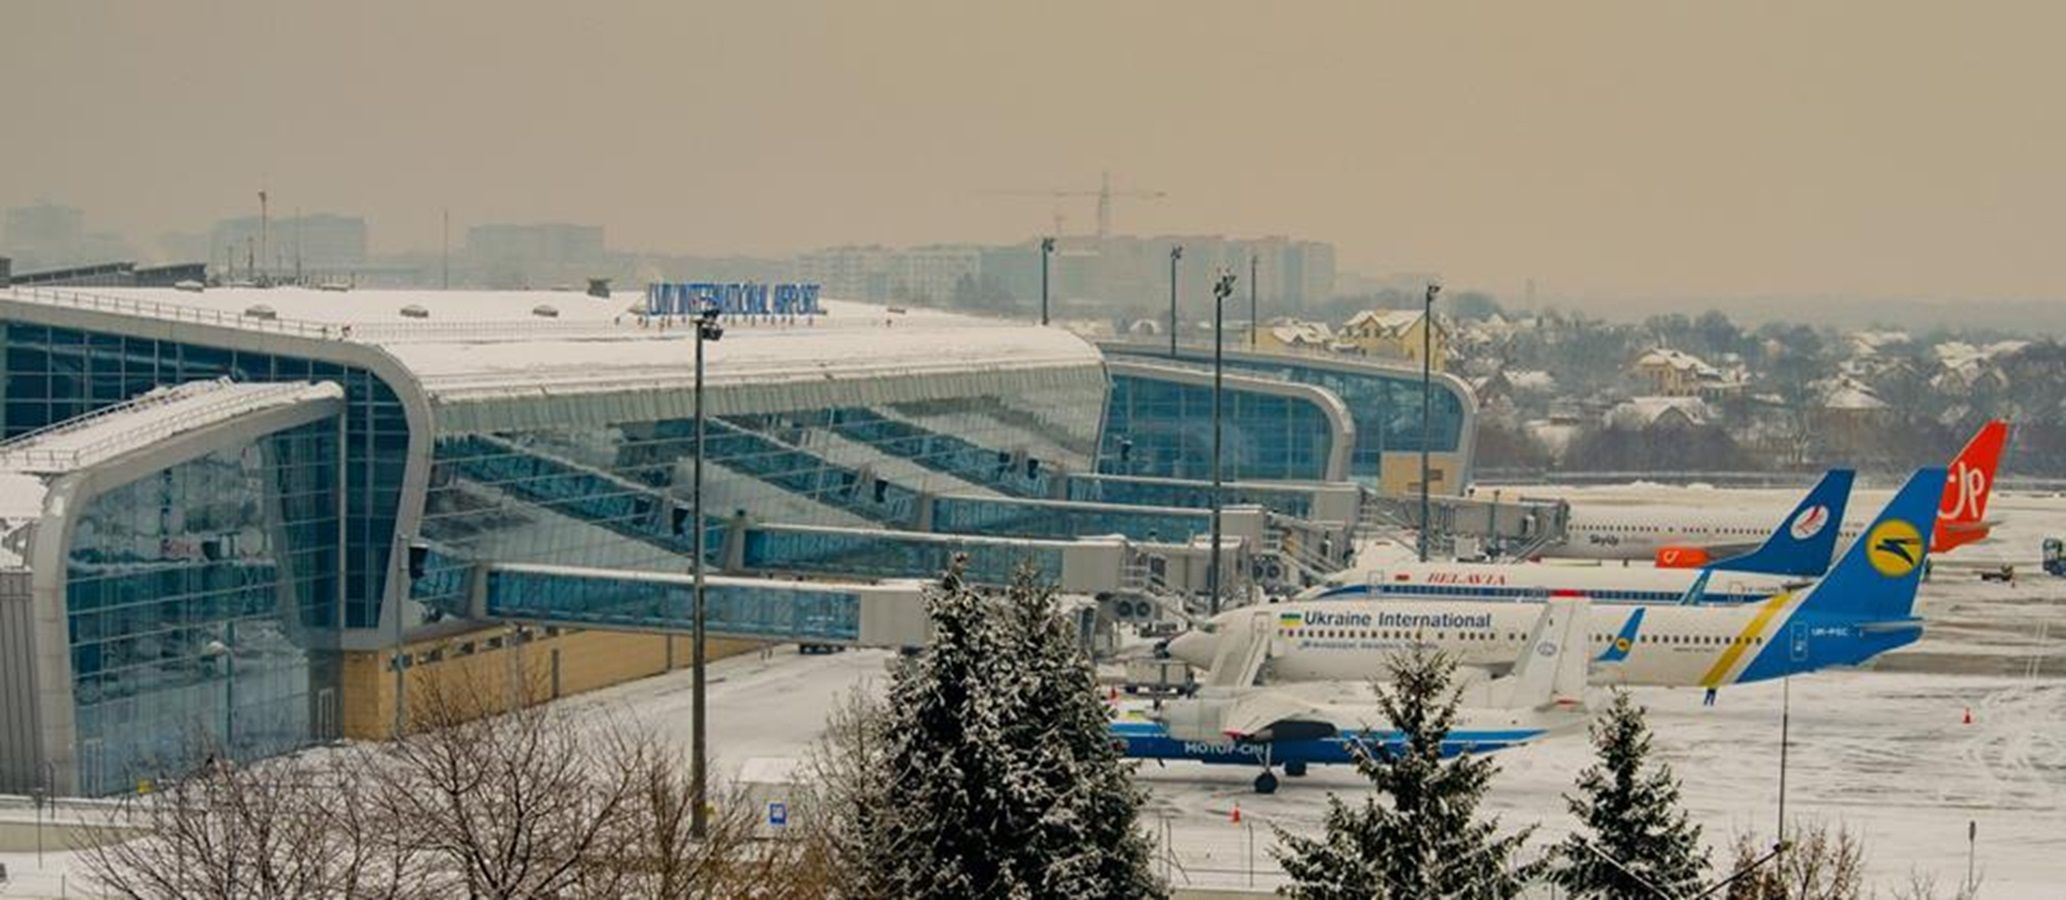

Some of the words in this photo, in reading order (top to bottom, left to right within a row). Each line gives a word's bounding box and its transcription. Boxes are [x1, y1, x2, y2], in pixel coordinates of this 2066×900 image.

[773, 284, 820, 315] AIRPORT
[1428, 573, 1506, 585] BELAVIA
[1304, 611, 1372, 626] Ukraine
[1378, 612, 1492, 628] International
